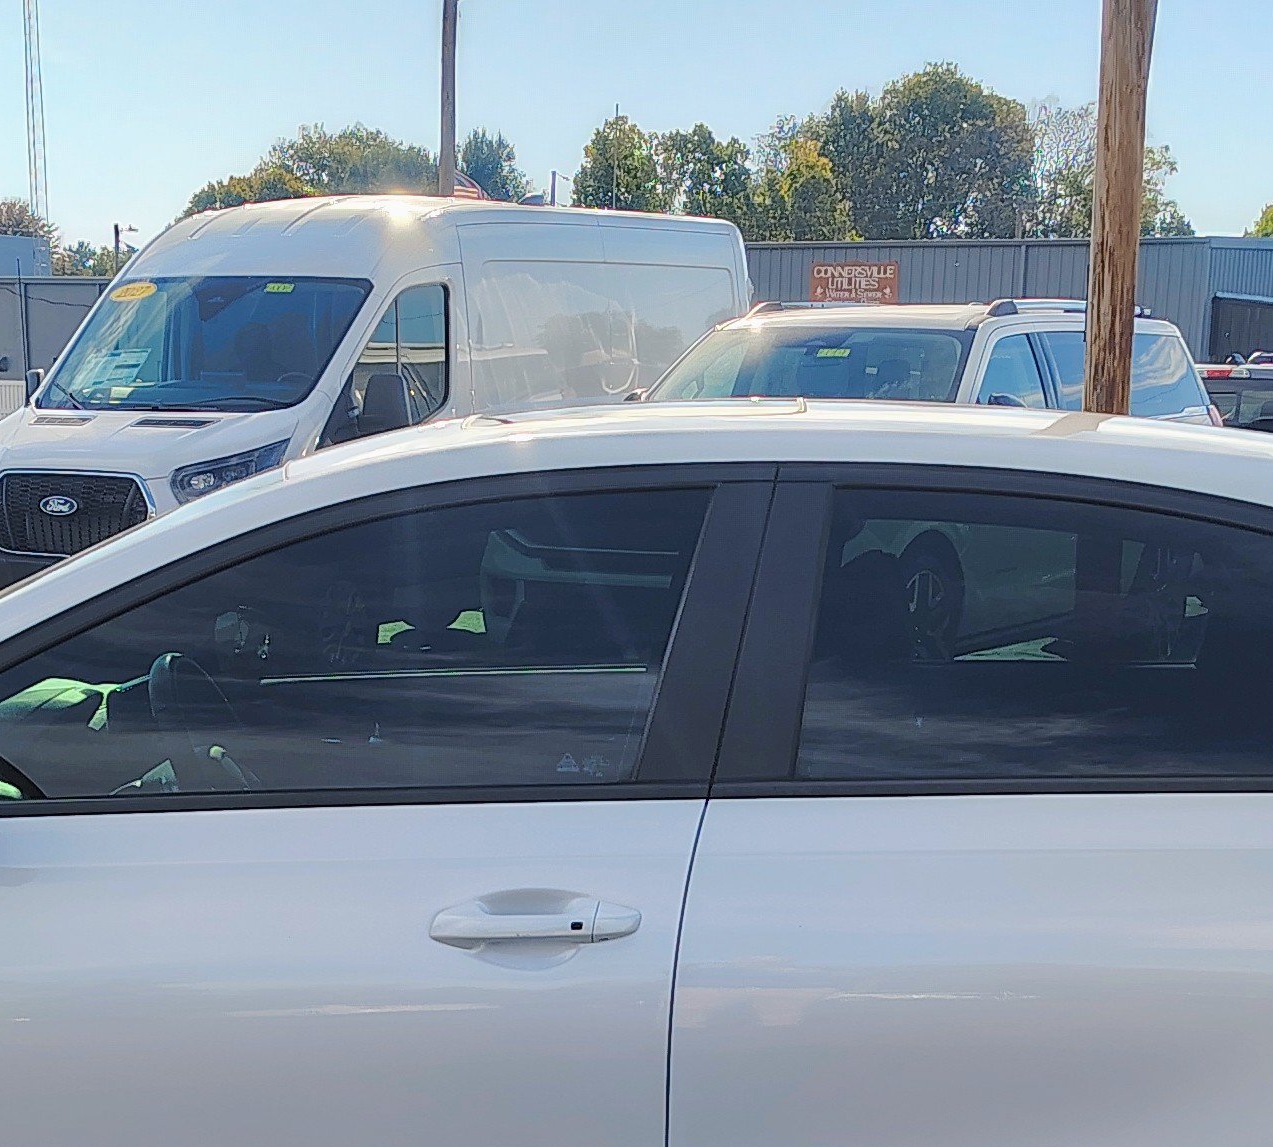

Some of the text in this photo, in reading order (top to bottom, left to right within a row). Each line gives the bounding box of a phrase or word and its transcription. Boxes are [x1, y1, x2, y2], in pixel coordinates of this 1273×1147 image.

[813, 265, 895, 279] CONNERSVILLE
[828, 277, 879, 289] UTILITIES
[46, 499, 71, 512] Ford
